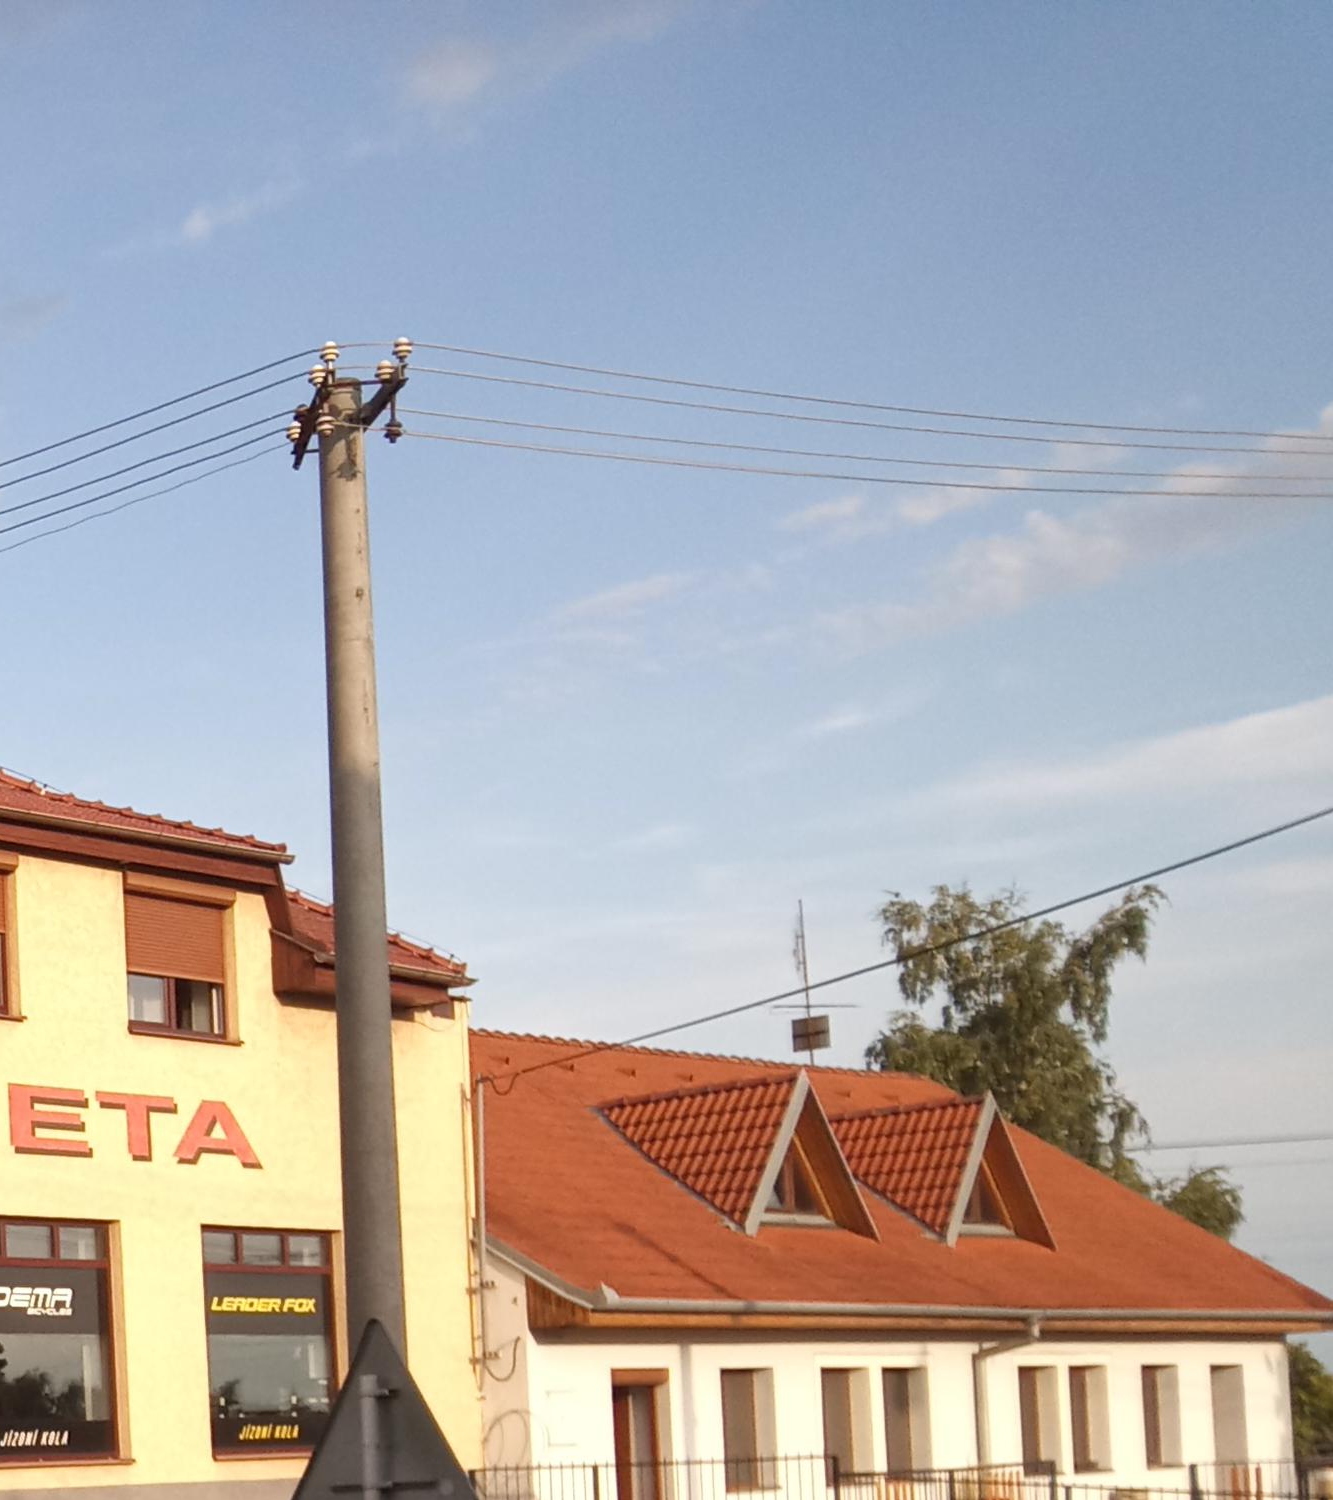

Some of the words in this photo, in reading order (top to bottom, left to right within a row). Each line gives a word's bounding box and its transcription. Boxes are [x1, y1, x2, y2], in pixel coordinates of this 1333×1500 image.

[211, 1296, 282, 1312] LEADER
[282, 1297, 316, 1313] FOX
[40, 1430, 69, 1446] KOLA
